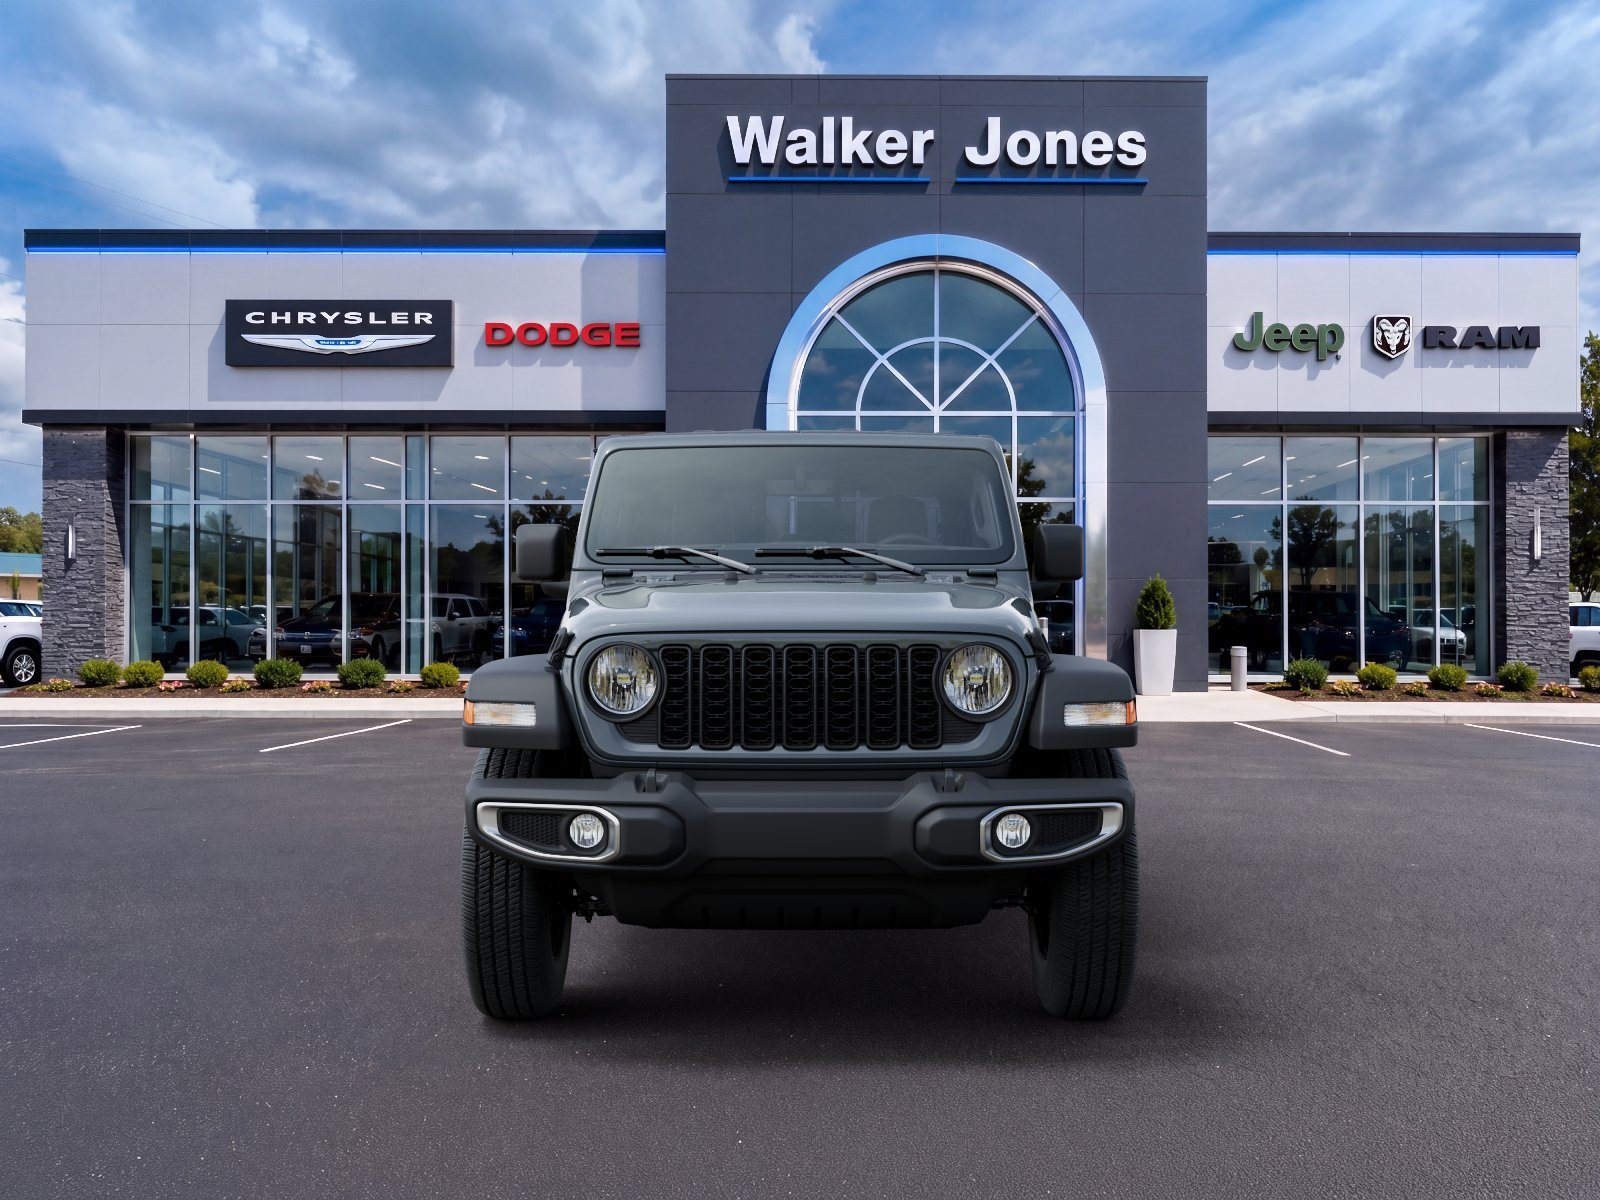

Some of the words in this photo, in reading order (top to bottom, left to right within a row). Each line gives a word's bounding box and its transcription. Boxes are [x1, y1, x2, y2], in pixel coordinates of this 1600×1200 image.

[726, 115, 935, 166] Walker
[964, 116, 1147, 166] Jones
[245, 311, 433, 325] CHRYSLER
[485, 322, 641, 347] DODGE
[1233, 311, 1345, 361] Jeep
[1423, 325, 1541, 349] RAM
